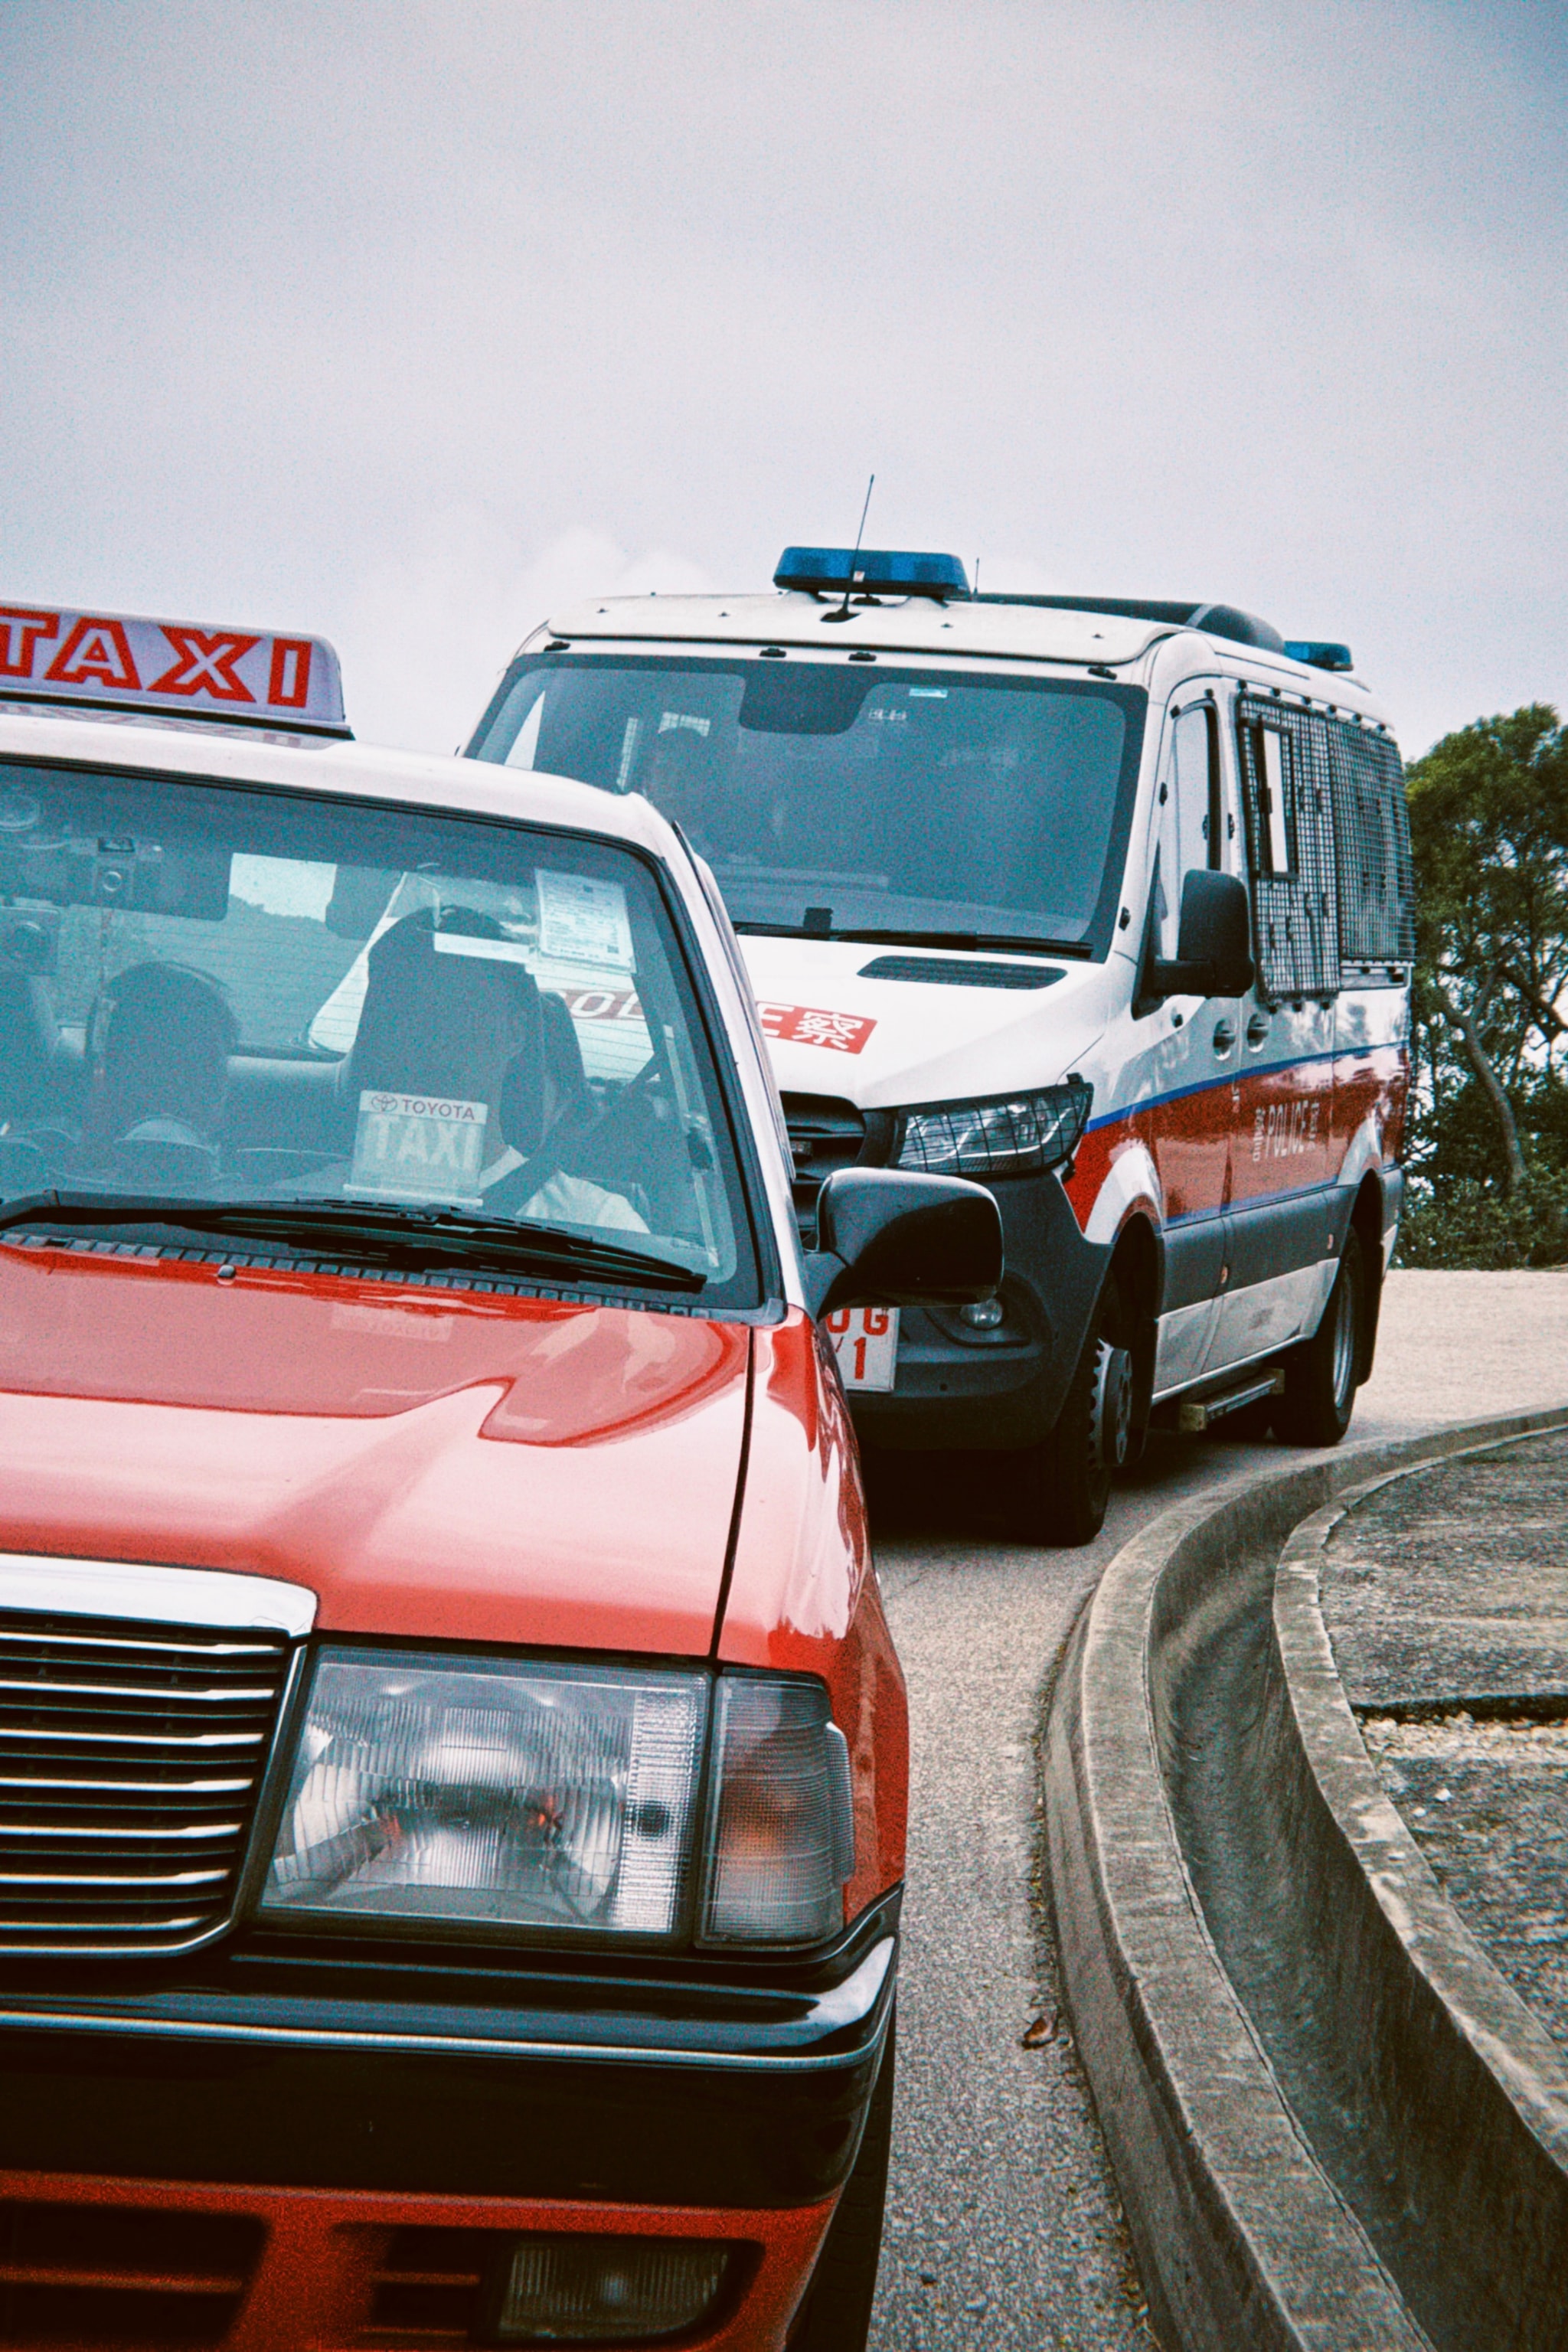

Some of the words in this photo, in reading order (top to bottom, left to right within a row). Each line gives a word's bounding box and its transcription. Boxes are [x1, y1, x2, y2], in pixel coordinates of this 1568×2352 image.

[0, 607, 312, 708] TAXI
[401, 1098, 475, 1121] TOYOTA
[1266, 1099, 1308, 1159] POLICE
[368, 1112, 478, 1171] TAXI
